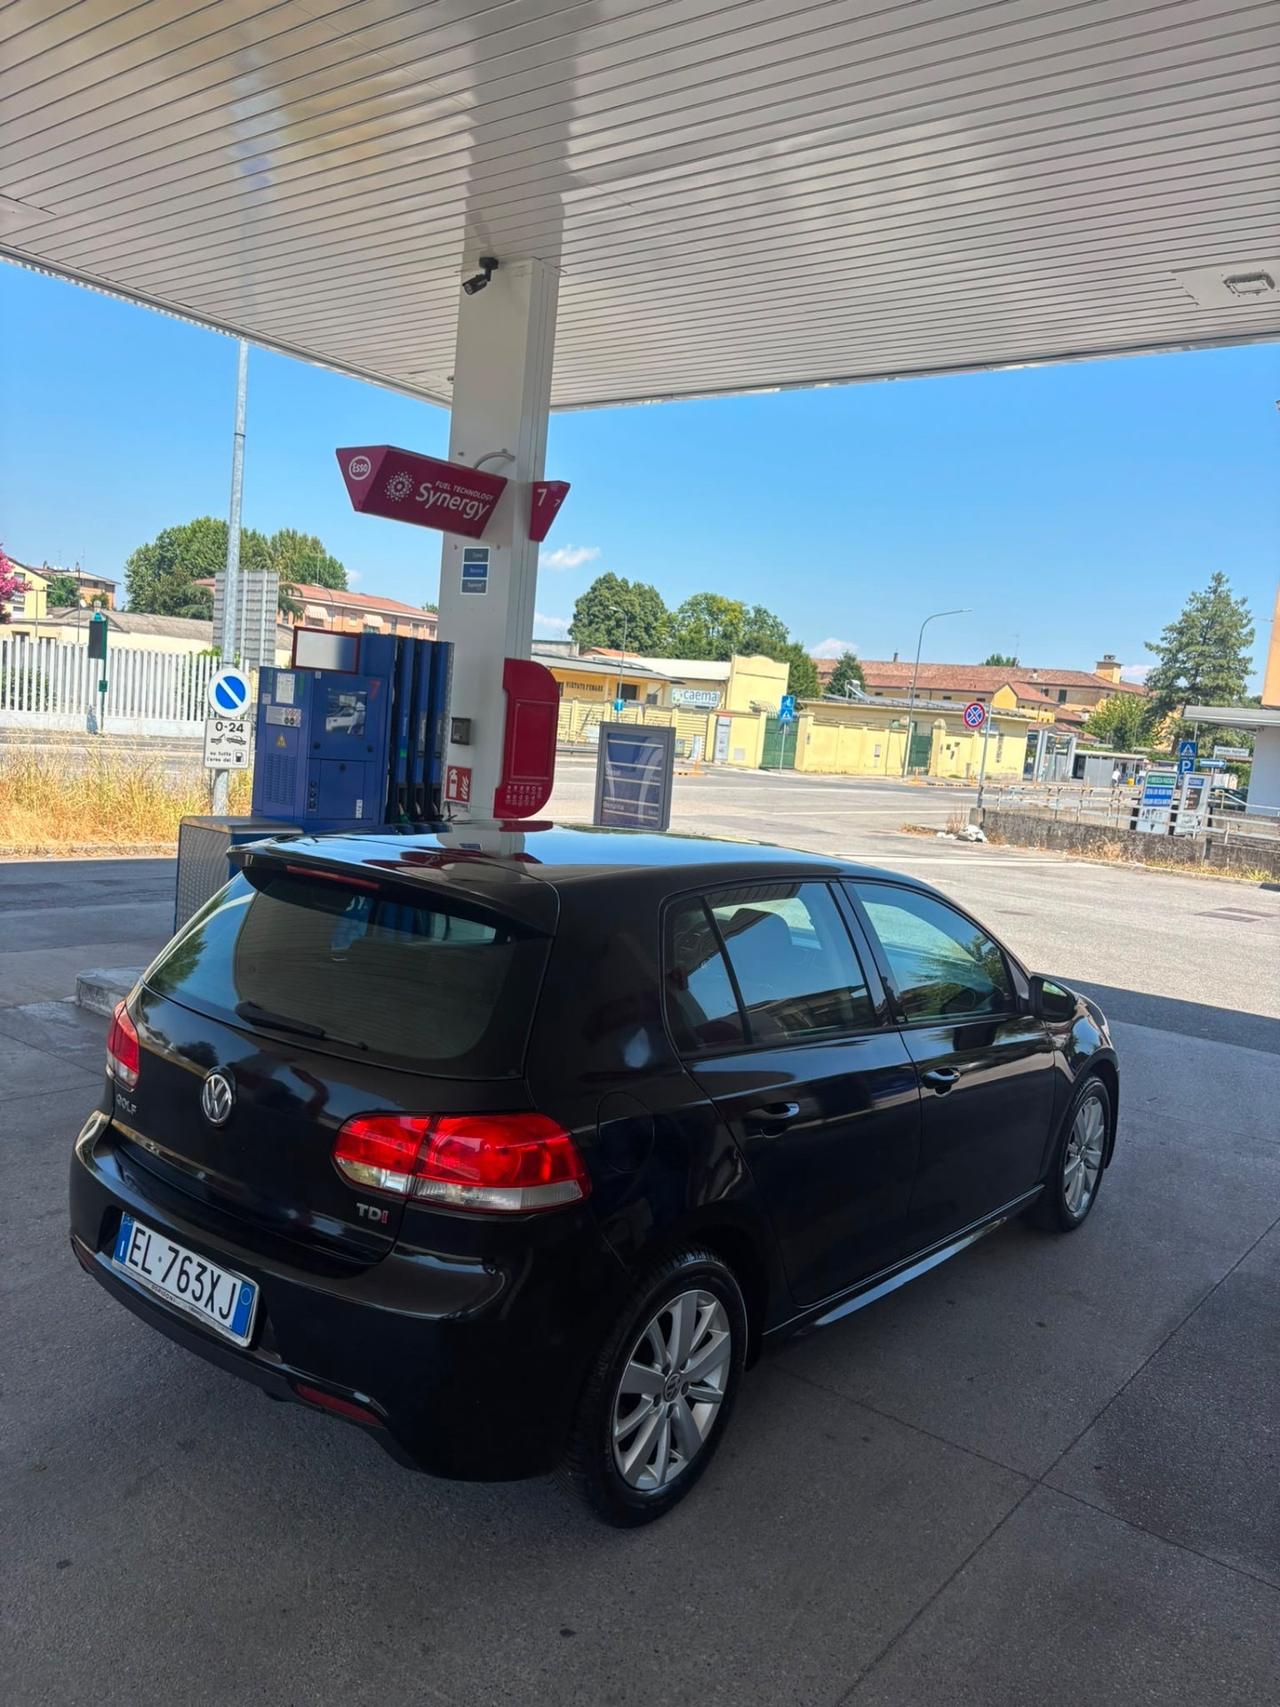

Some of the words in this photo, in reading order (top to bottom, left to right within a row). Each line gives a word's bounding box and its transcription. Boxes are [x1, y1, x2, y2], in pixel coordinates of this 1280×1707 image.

[435, 480, 452, 491] FUEL
[453, 484, 494, 501] TECHNOLOGY
[415, 482, 491, 521] Synergy
[368, 680, 380, 702] 7
[683, 690, 718, 702] caema
[215, 721, 244, 733] 0-24
[1182, 761, 1191, 772] P
[128, 1230, 152, 1276] EL
[160, 1245, 236, 1319] 763XJ
